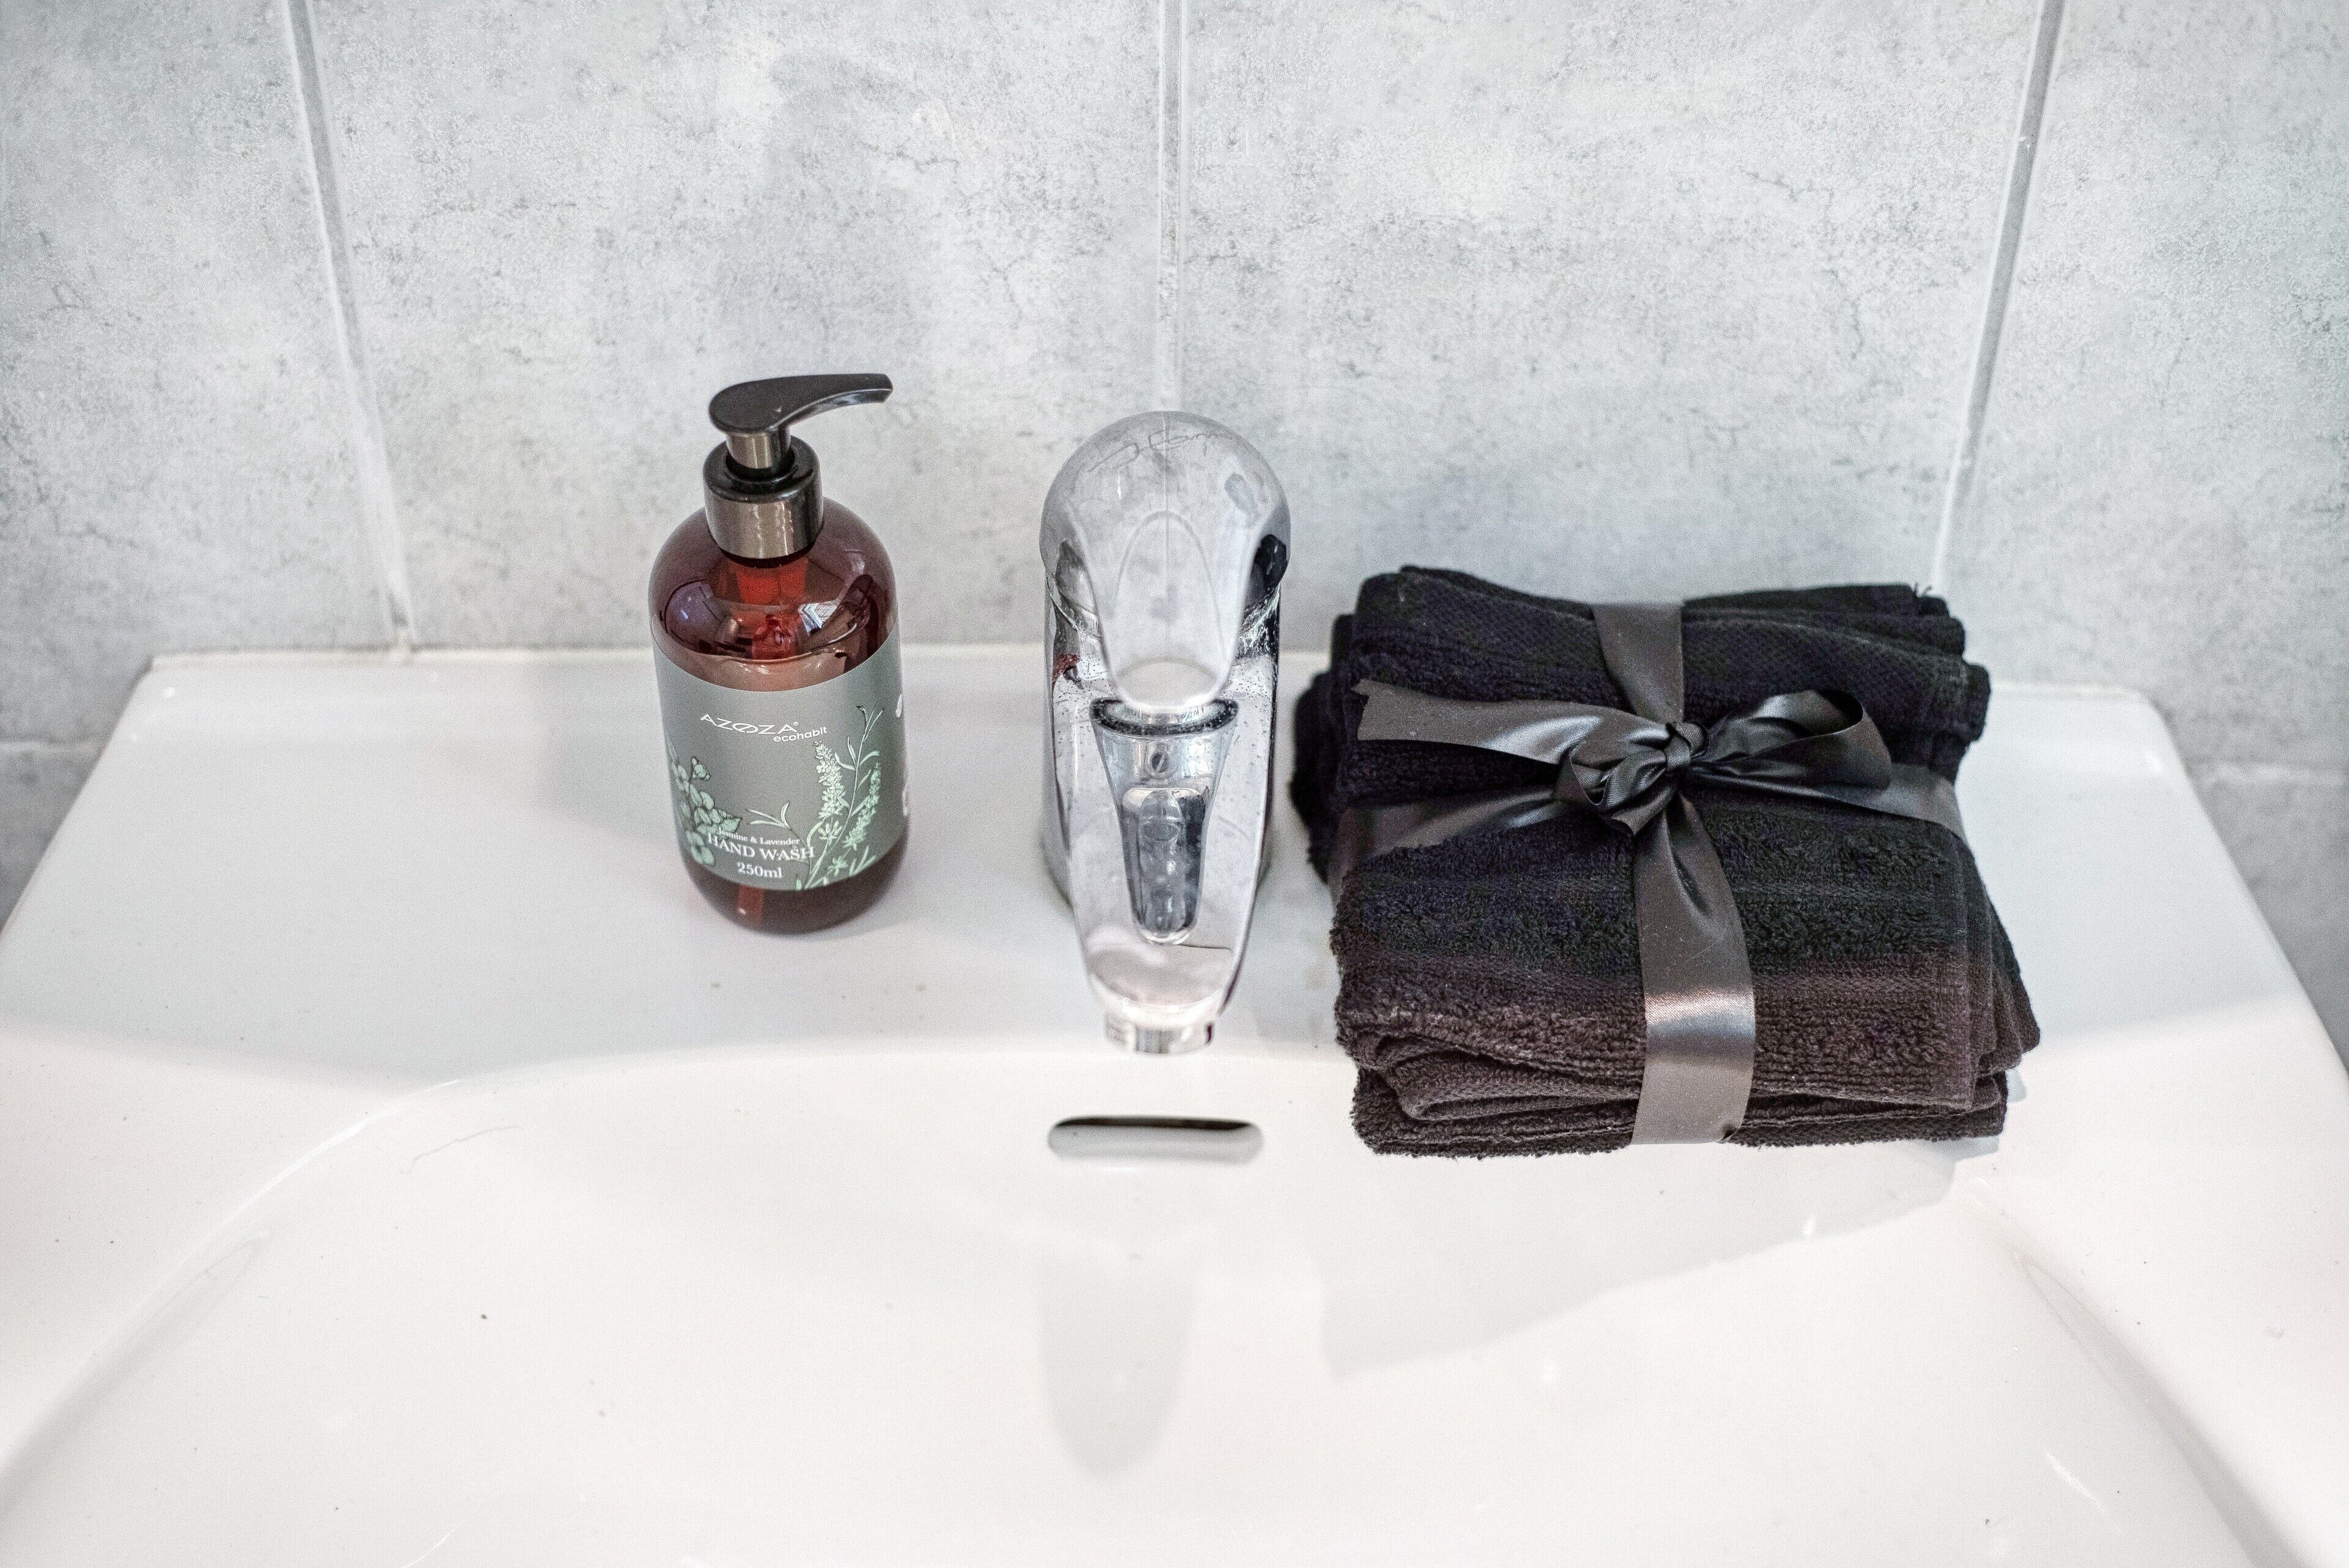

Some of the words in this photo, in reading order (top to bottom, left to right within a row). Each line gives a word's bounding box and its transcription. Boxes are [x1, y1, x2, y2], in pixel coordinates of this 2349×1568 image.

[773, 726, 827, 742] ecohabit
[718, 827, 748, 842] Jasmine
[708, 833, 755, 857] HAND
[759, 847, 815, 860] WASH
[737, 862, 782, 879] 250ml
